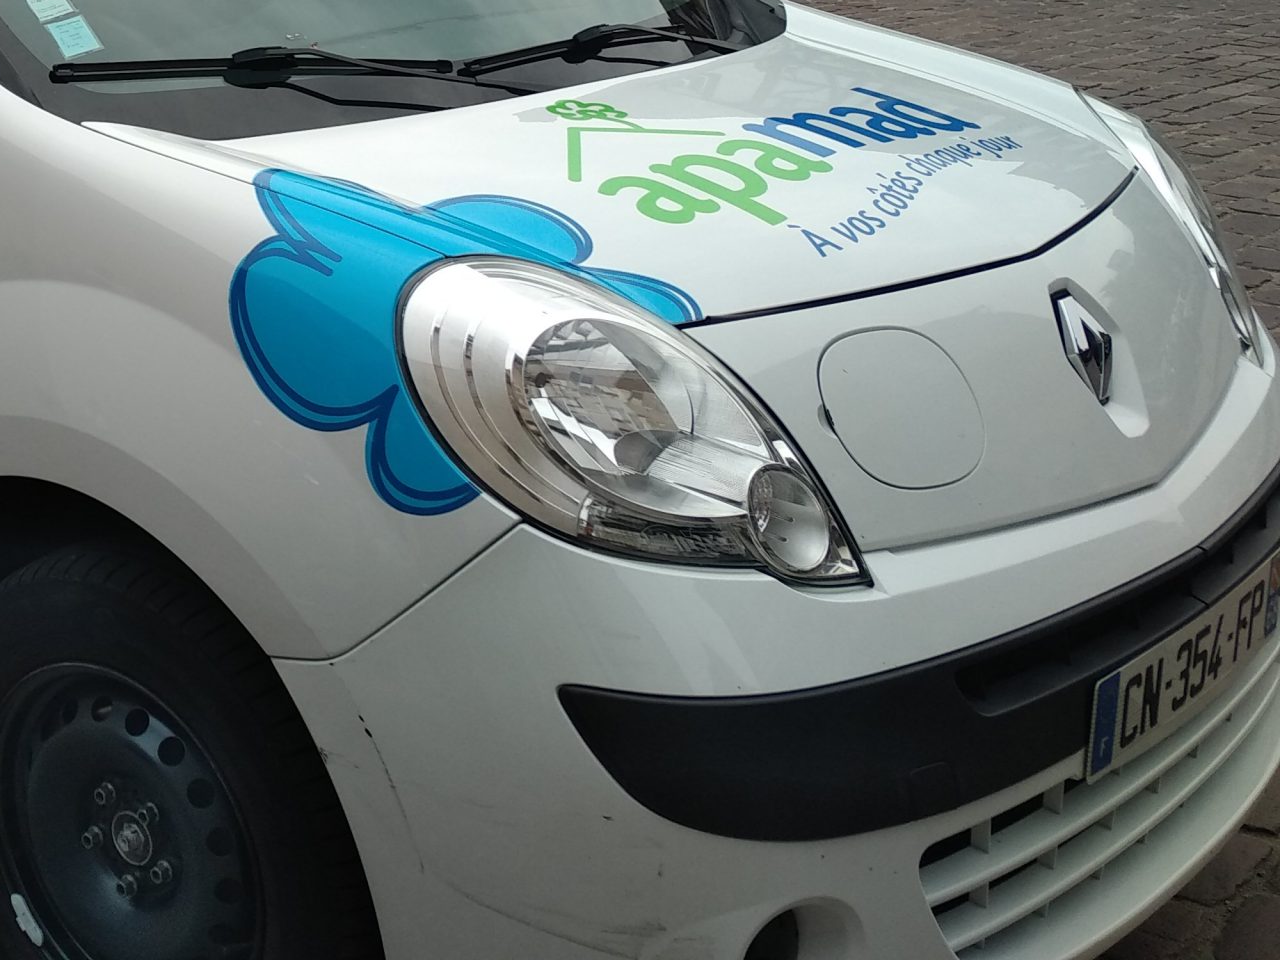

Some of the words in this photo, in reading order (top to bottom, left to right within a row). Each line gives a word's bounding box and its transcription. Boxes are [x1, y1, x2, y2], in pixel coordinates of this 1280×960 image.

[597, 87, 982, 226] apamad
[786, 223, 844, 259] À
[835, 208, 887, 244] vos
[865, 171, 924, 217] côtés
[905, 136, 981, 181] chaque
[976, 134, 1025, 162] jour
[1120, 579, 1265, 749] CN-354-FP
